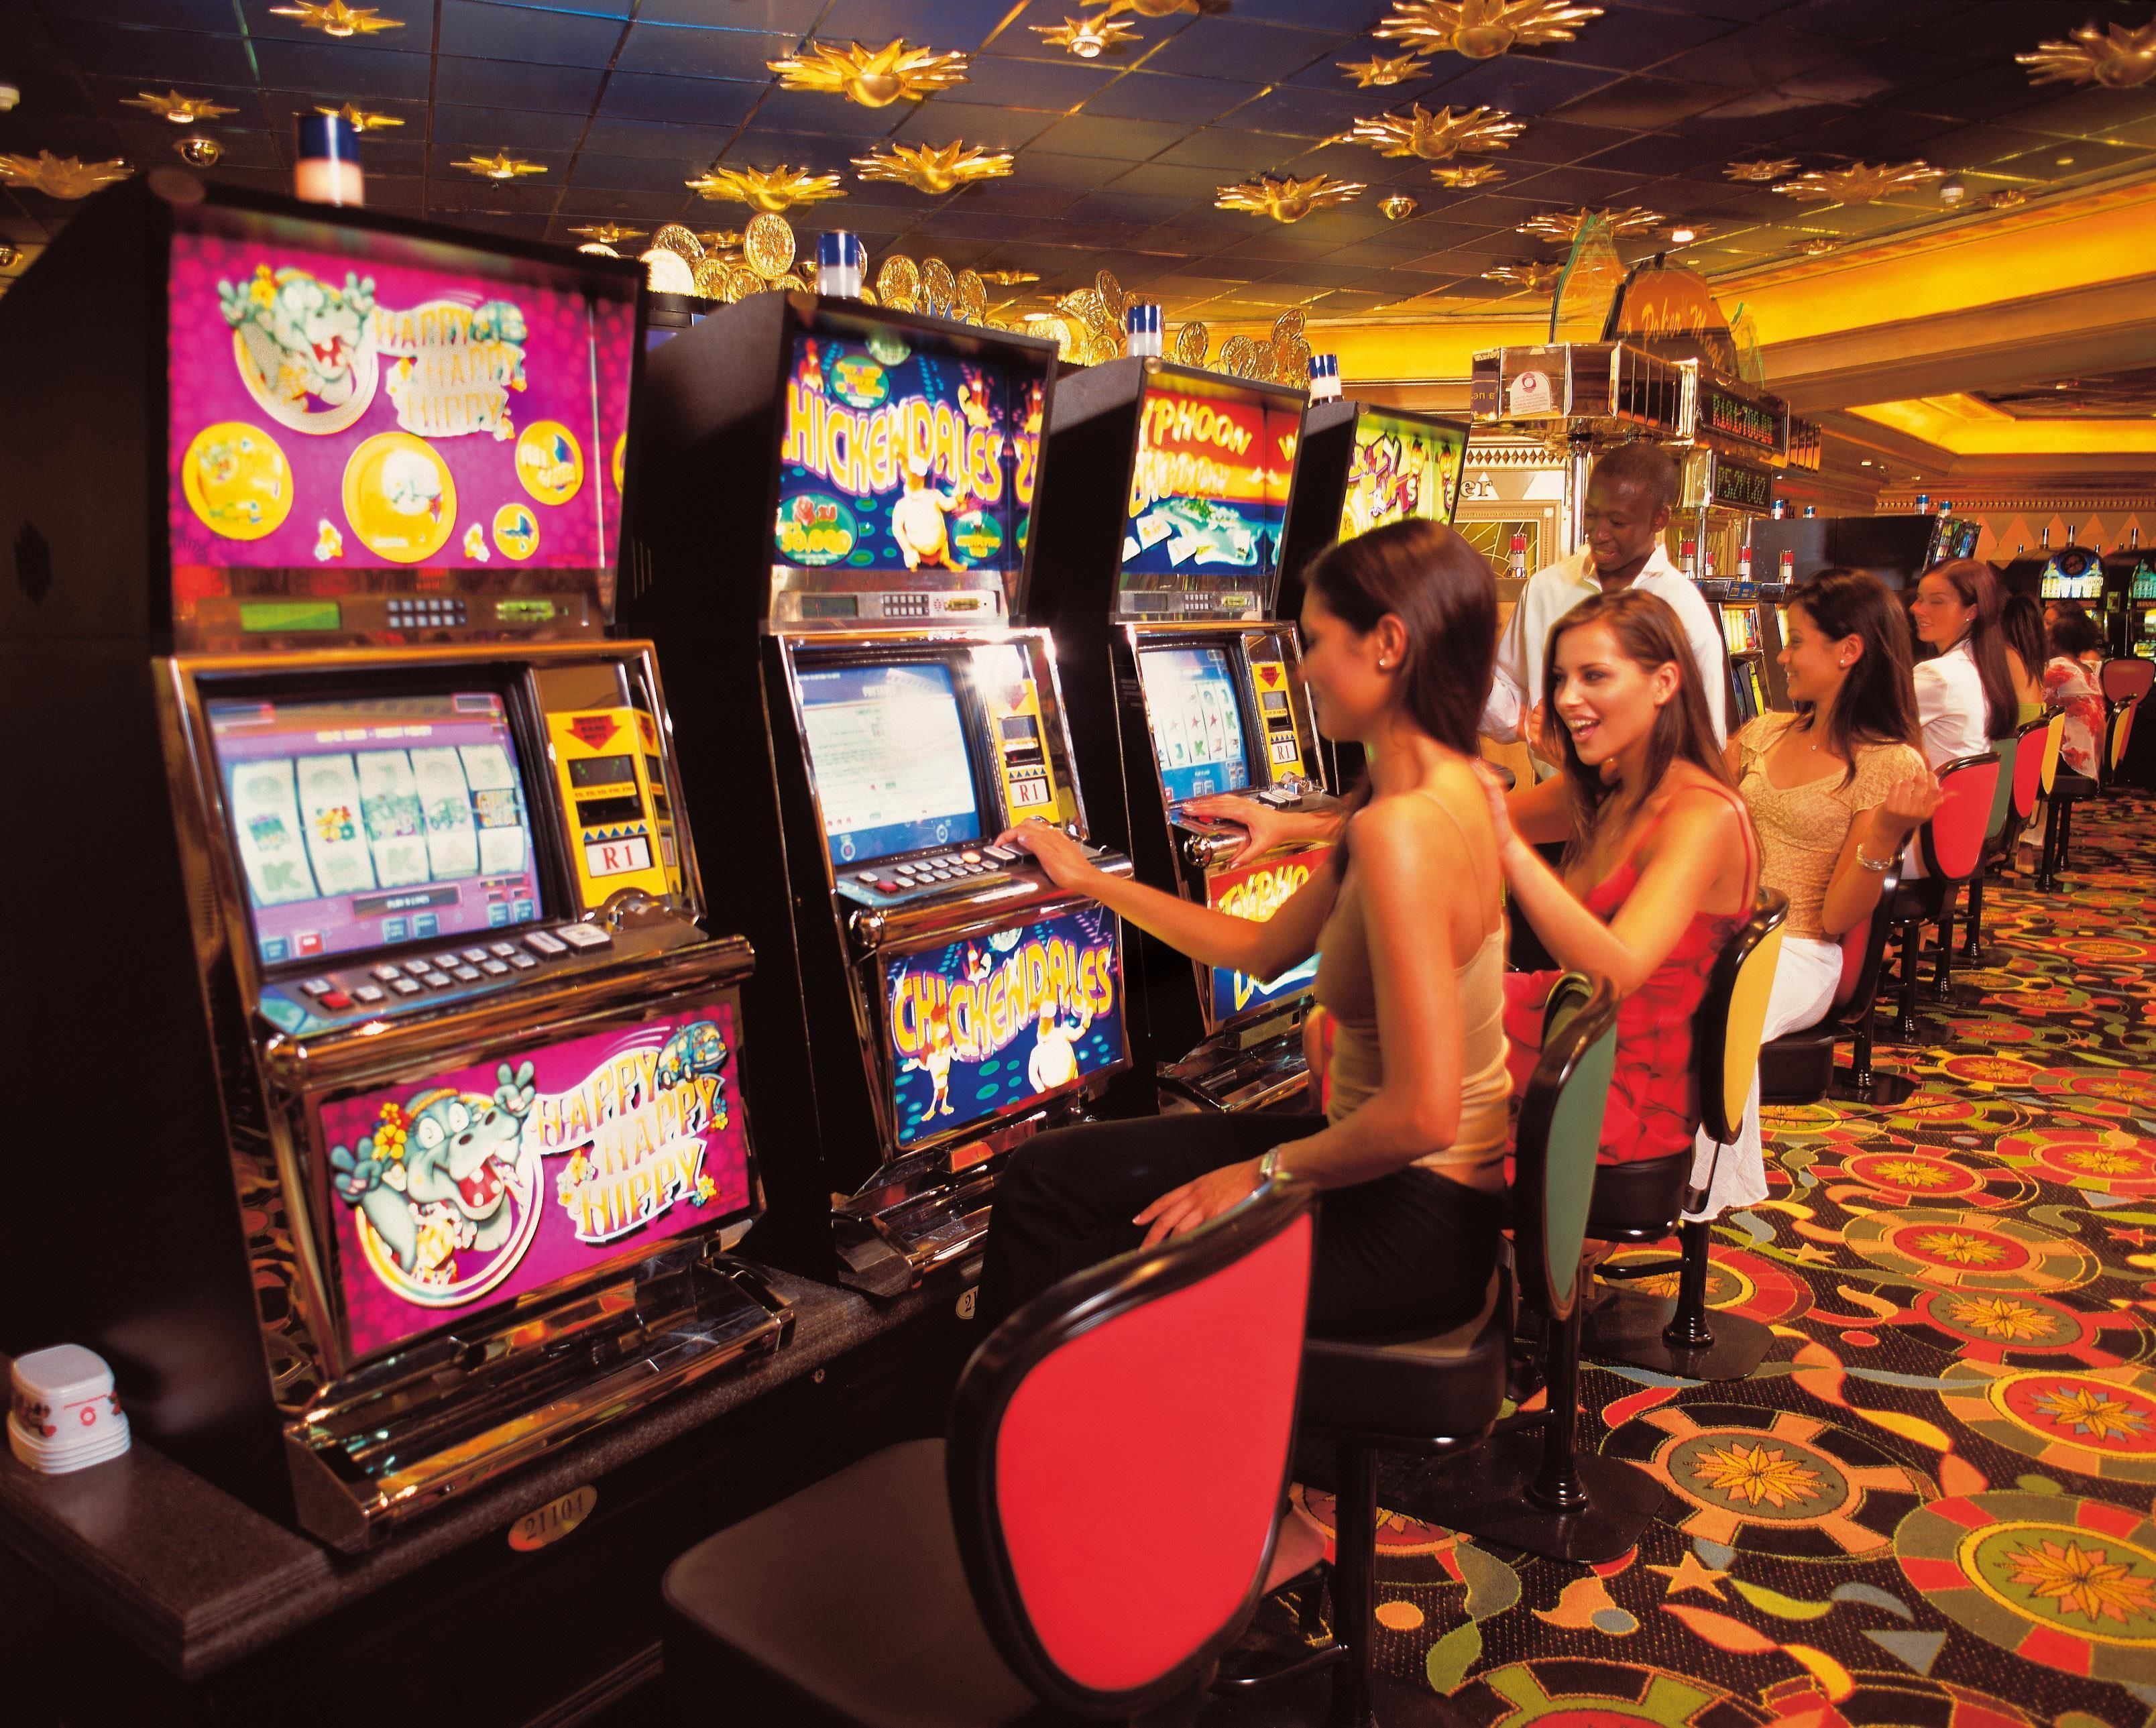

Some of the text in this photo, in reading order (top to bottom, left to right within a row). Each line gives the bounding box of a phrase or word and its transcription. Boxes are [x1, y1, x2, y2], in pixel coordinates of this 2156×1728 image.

[374, 306, 473, 349] HAPPY
[781, 382, 1002, 504] HICKENDALES
[892, 937, 1113, 1059] CHICKENDALES
[537, 1051, 659, 1147] HAPPY
[605, 1077, 717, 1175] HAPPY
[581, 1144, 700, 1236] HIPPY
[524, 1491, 583, 1541] 21101
